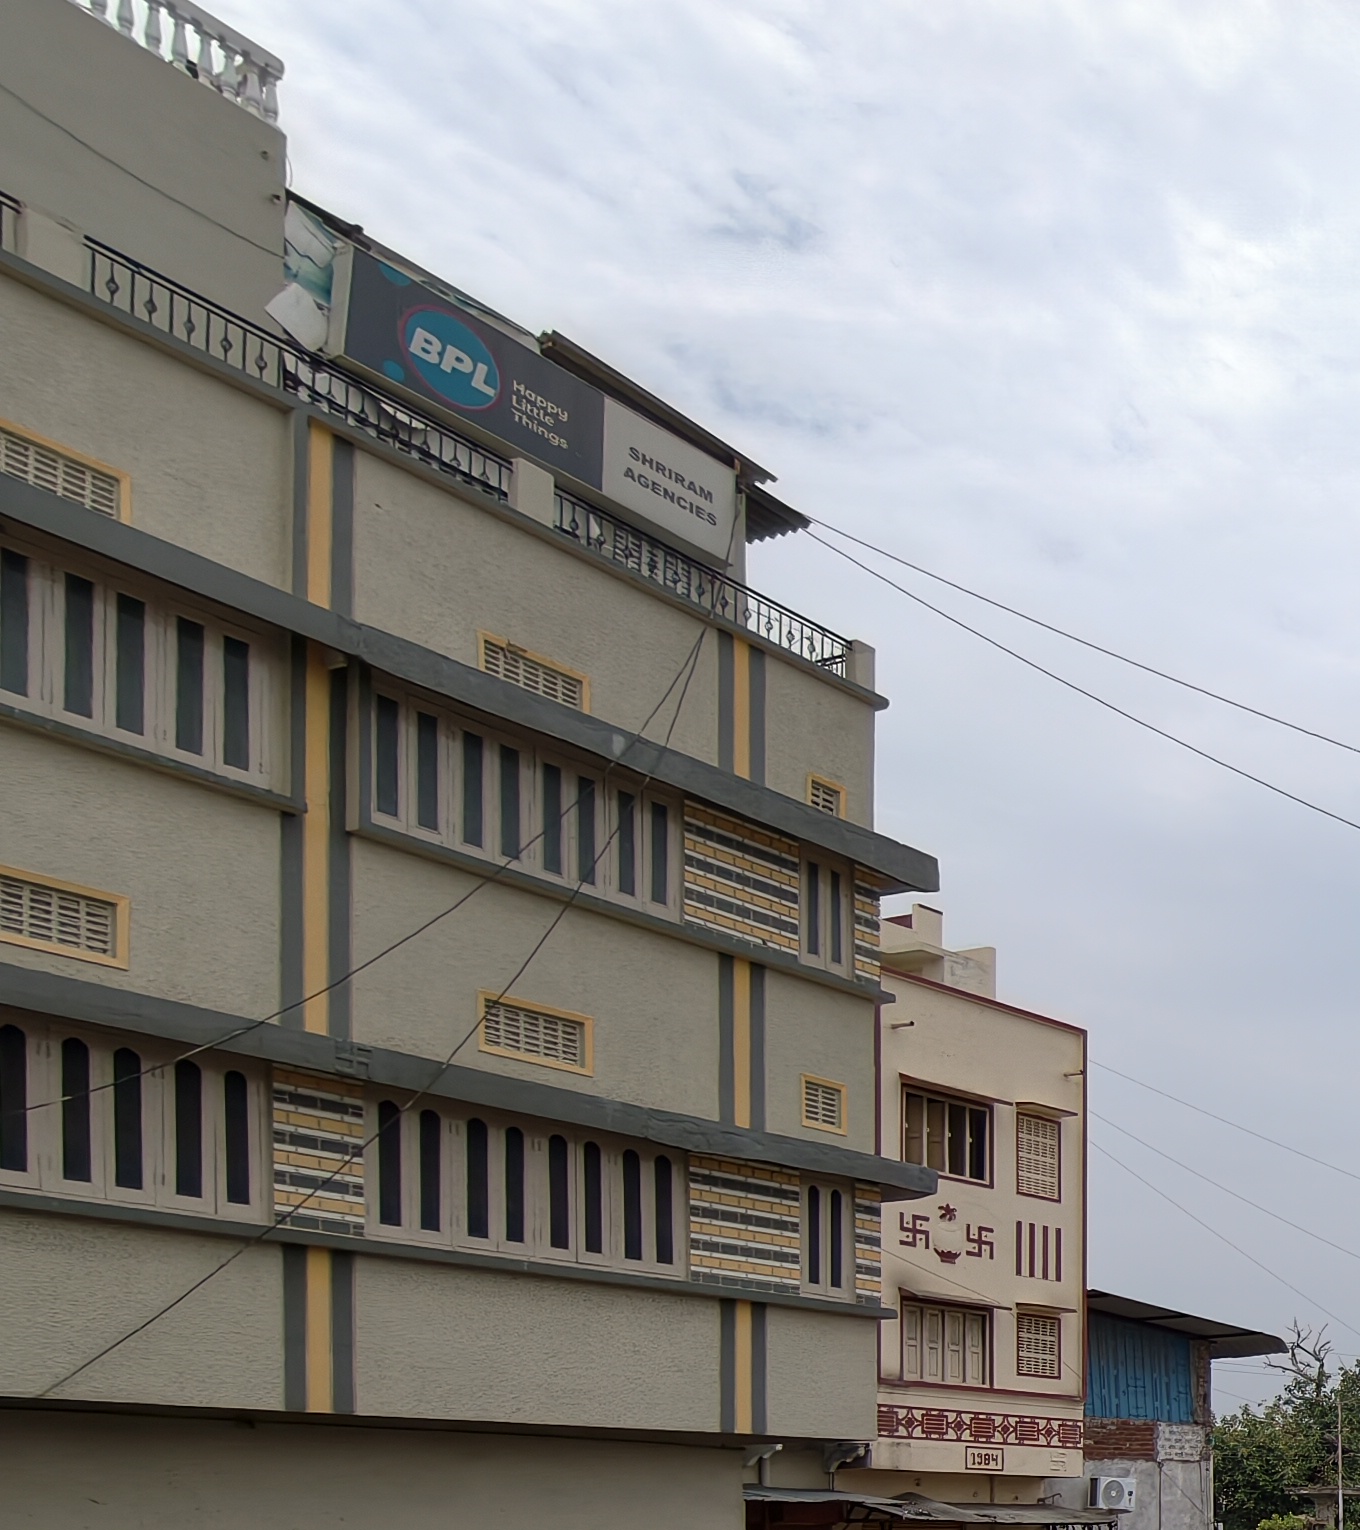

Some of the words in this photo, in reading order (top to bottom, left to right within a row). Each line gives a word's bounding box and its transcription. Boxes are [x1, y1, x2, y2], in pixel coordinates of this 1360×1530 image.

[408, 327, 497, 397] BPL
[511, 395, 555, 427] Little
[512, 379, 569, 423] Happy
[511, 407, 569, 450] Things
[623, 467, 718, 527] AGENCIES
[628, 446, 714, 504] SHRIRAM
[970, 1452, 999, 1467] 1984
